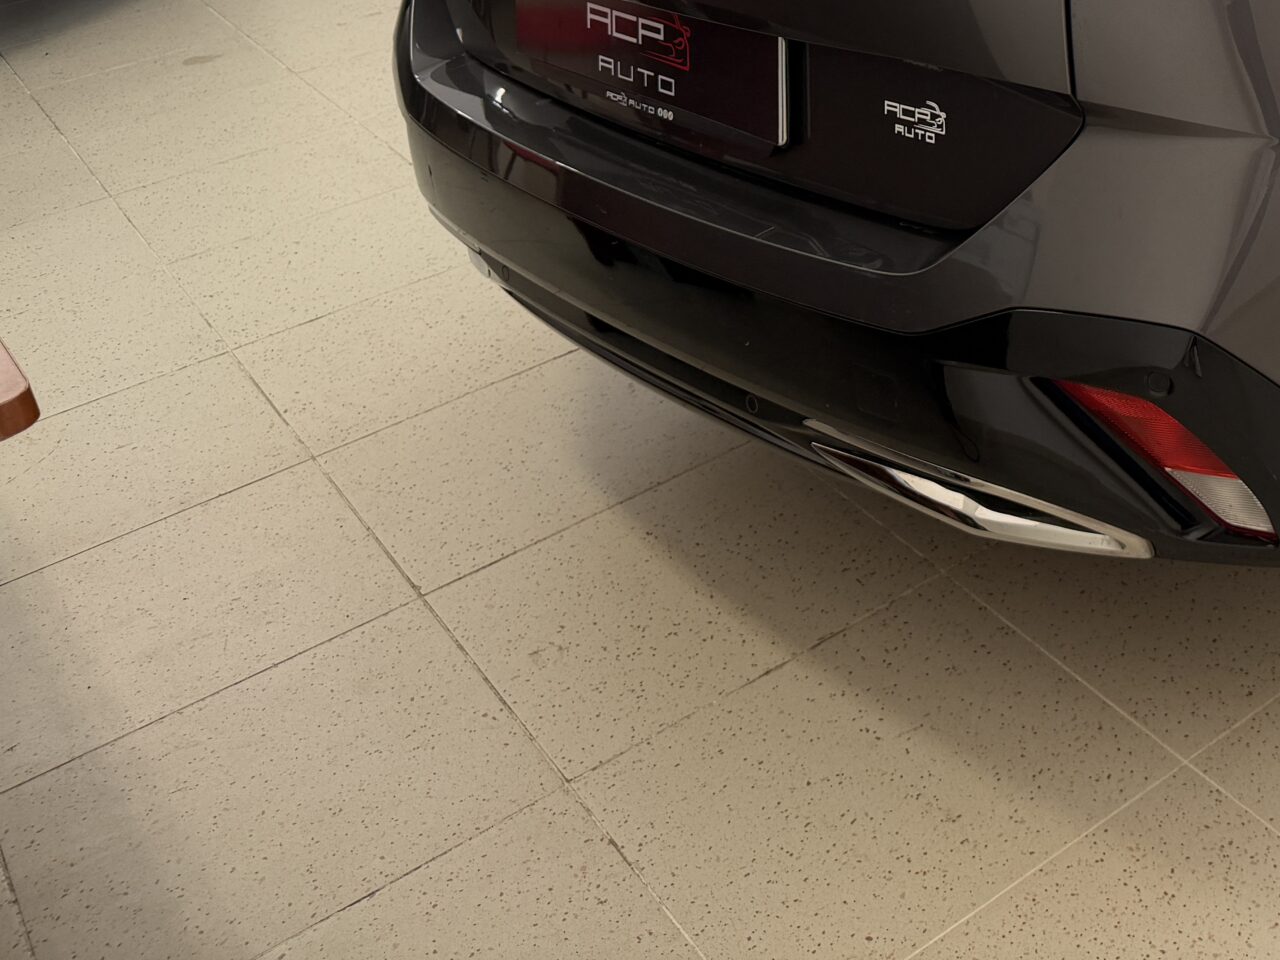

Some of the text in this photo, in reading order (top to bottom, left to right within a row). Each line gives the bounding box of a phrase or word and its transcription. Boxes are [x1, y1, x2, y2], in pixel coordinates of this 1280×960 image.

[586, 2, 664, 45] ACP
[598, 54, 675, 97] AUTO
[628, 98, 655, 115] AUTO
[894, 123, 936, 144] AUTO
